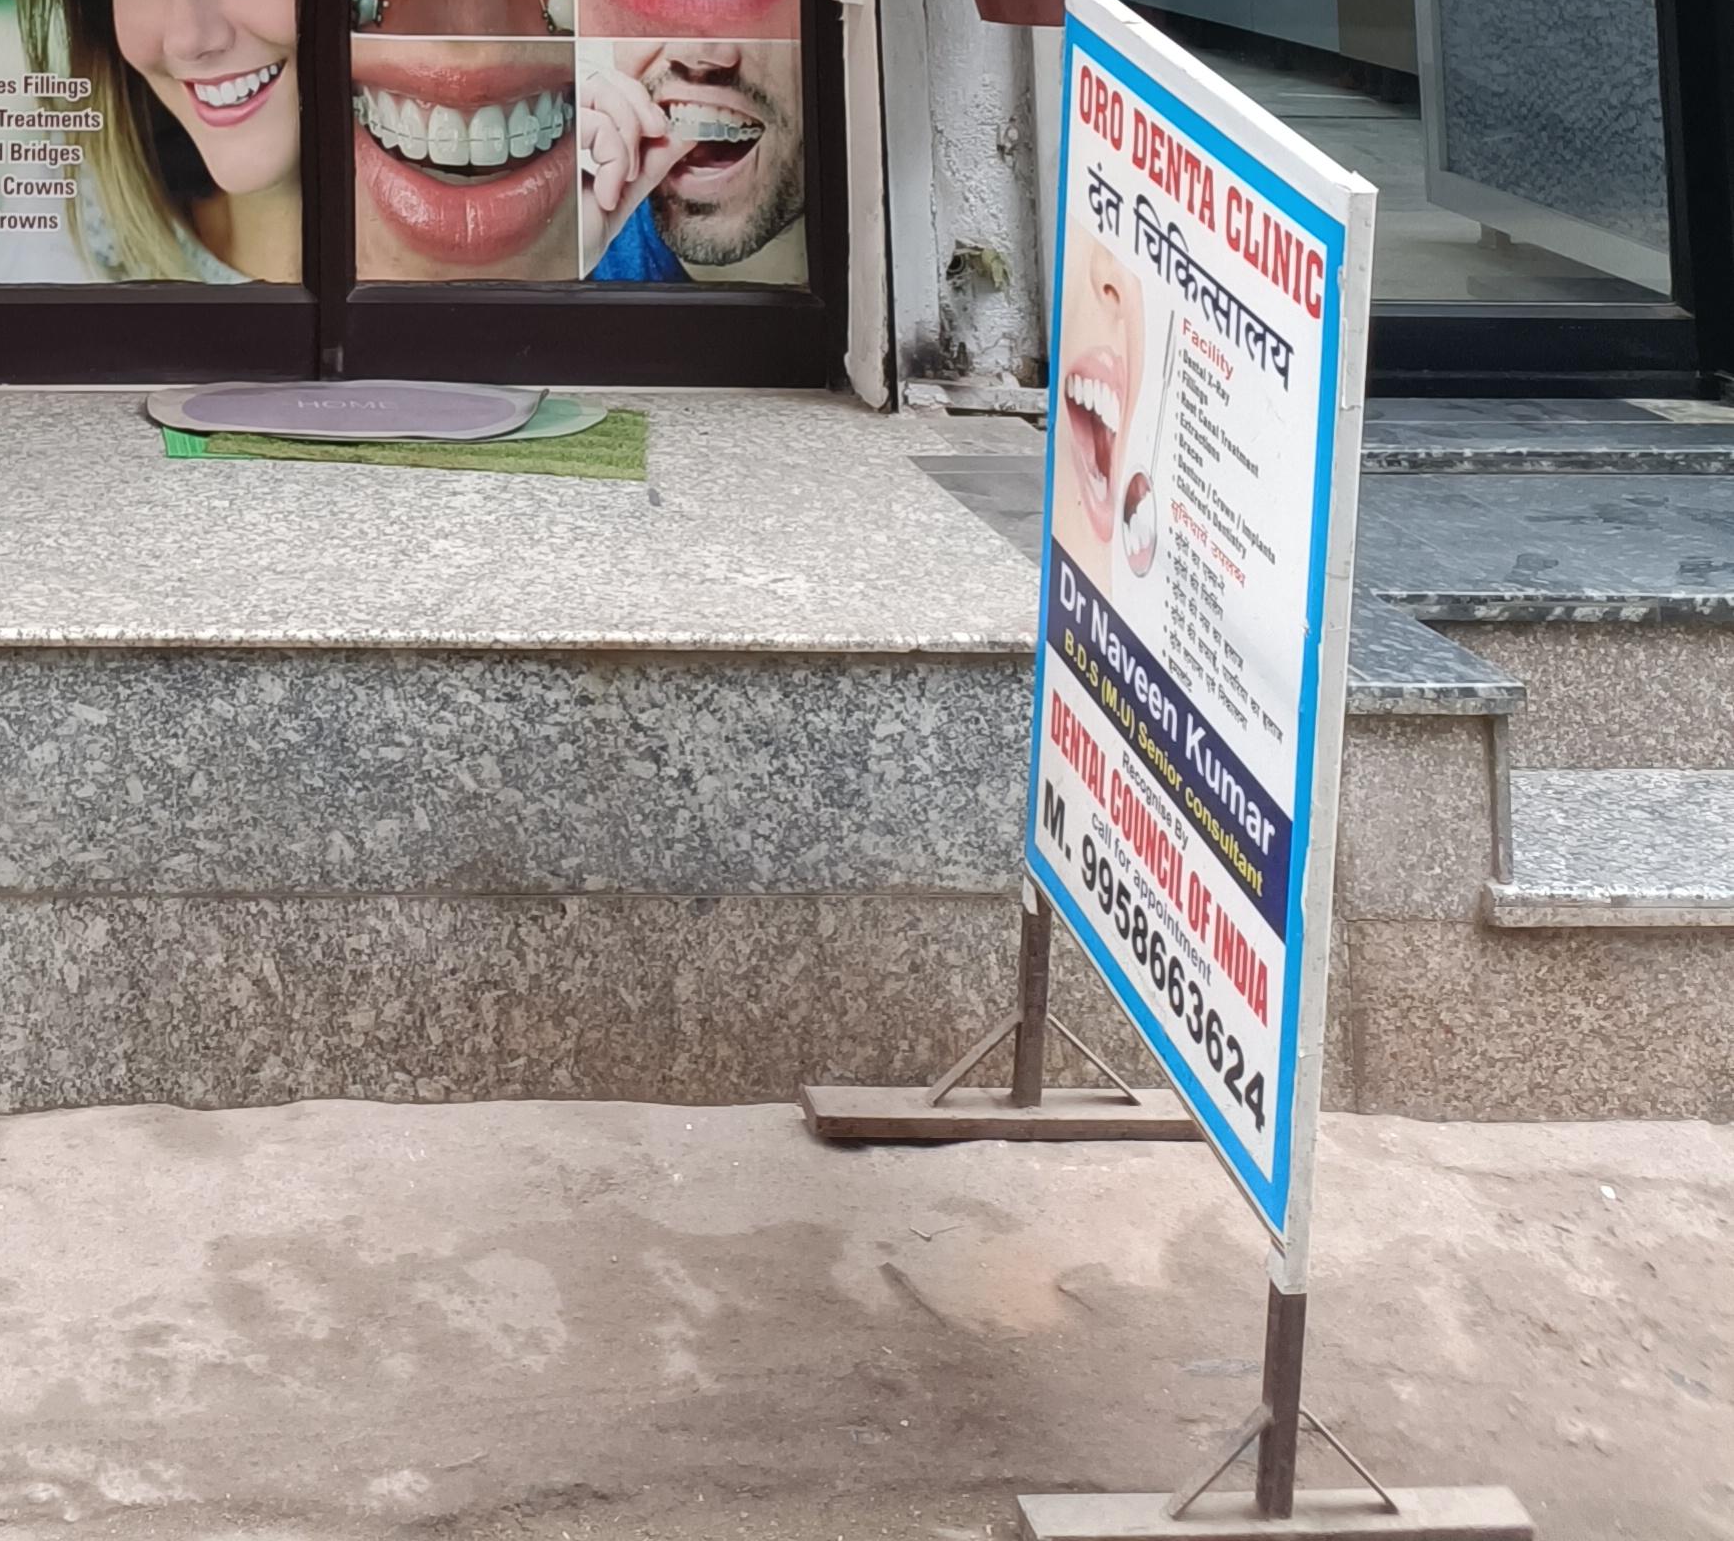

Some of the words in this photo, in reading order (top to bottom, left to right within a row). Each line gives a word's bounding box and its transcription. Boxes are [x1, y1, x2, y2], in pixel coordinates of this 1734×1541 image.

[2, 177, 76, 196] Crowns
[9, 143, 82, 167] Bridges
[23, 77, 90, 100] Fillings
[1079, 63, 1125, 153] ORO
[1132, 106, 1217, 236] DENTA
[1225, 185, 1326, 320] CLINIC
[1087, 162, 1124, 243] दंत
[1133, 192, 1295, 392] चिकित्सालय
[1182, 317, 1234, 381] Facility
[1058, 560, 1088, 625] Dr
[1089, 601, 1179, 737] Naveen
[1184, 712, 1277, 856] Kumar
[1063, 629, 1099, 692] B.D.S
[1099, 666, 1136, 738] (M.U)
[1136, 707, 1184, 794] Senior
[1184, 776, 1264, 899] consultant
[1120, 747, 1172, 831] Recognise
[1173, 814, 1189, 852] By
[1042, 775, 1073, 862] M.
[1079, 832, 1267, 1134] 9958663624
[1049, 687, 1108, 809] DENTAL
[1108, 767, 1184, 916] COUNCIL
[1186, 871, 1212, 948] OF
[1212, 902, 1269, 1030] INDIA
[1090, 811, 1115, 854] call
[1116, 834, 1133, 873] for
[1133, 858, 1213, 988] appointment
